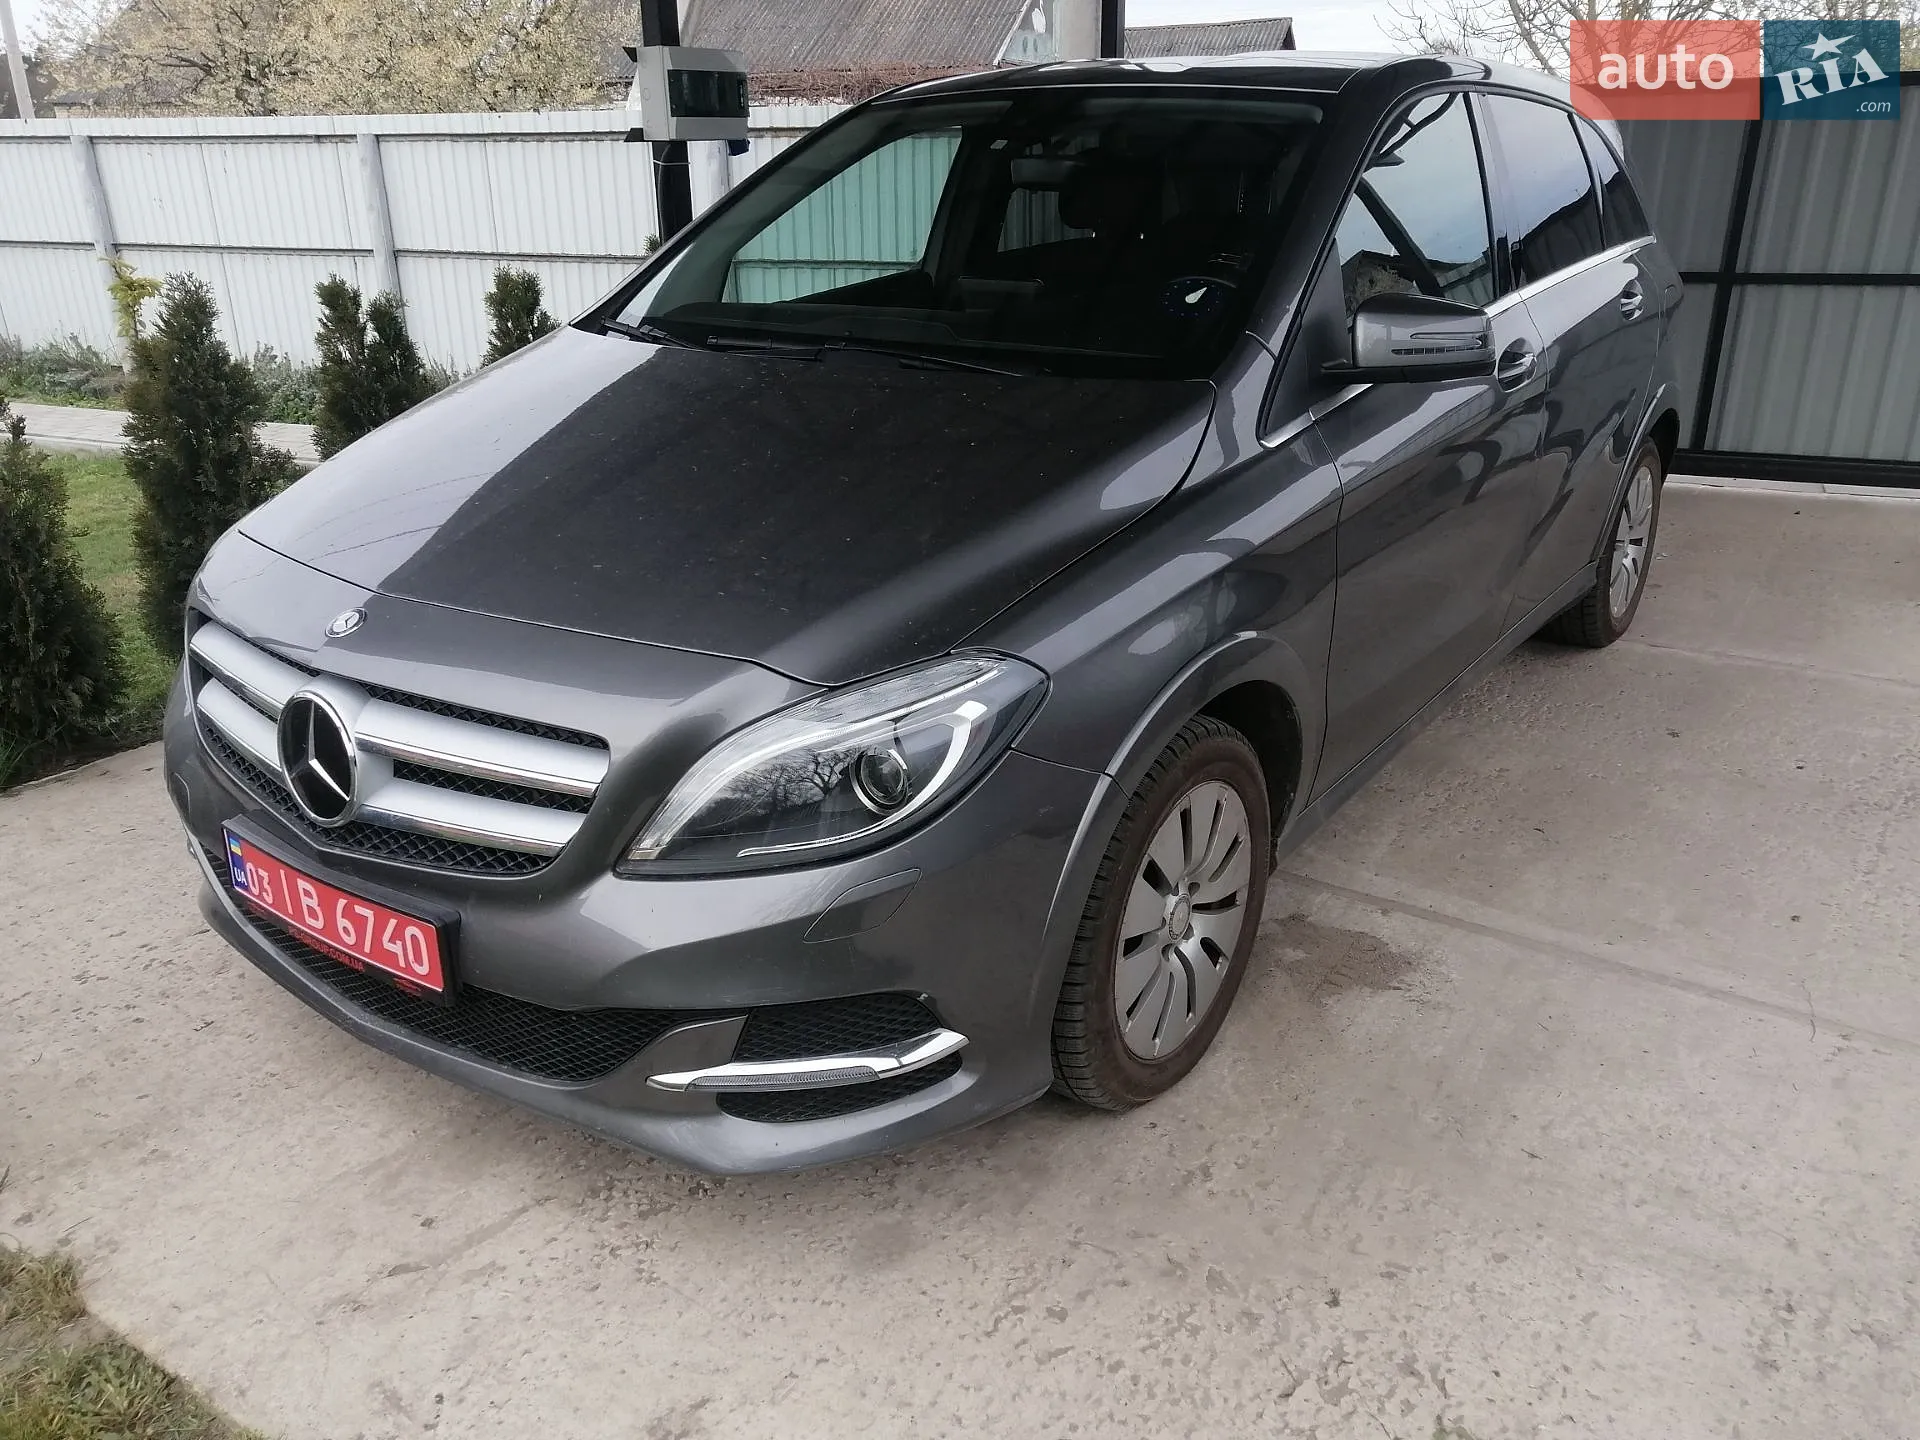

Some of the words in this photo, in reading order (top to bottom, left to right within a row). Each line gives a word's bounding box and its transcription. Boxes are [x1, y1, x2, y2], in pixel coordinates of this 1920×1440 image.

[234, 867, 248, 886] UA
[246, 862, 273, 904] 03
[336, 899, 430, 976] 6740
